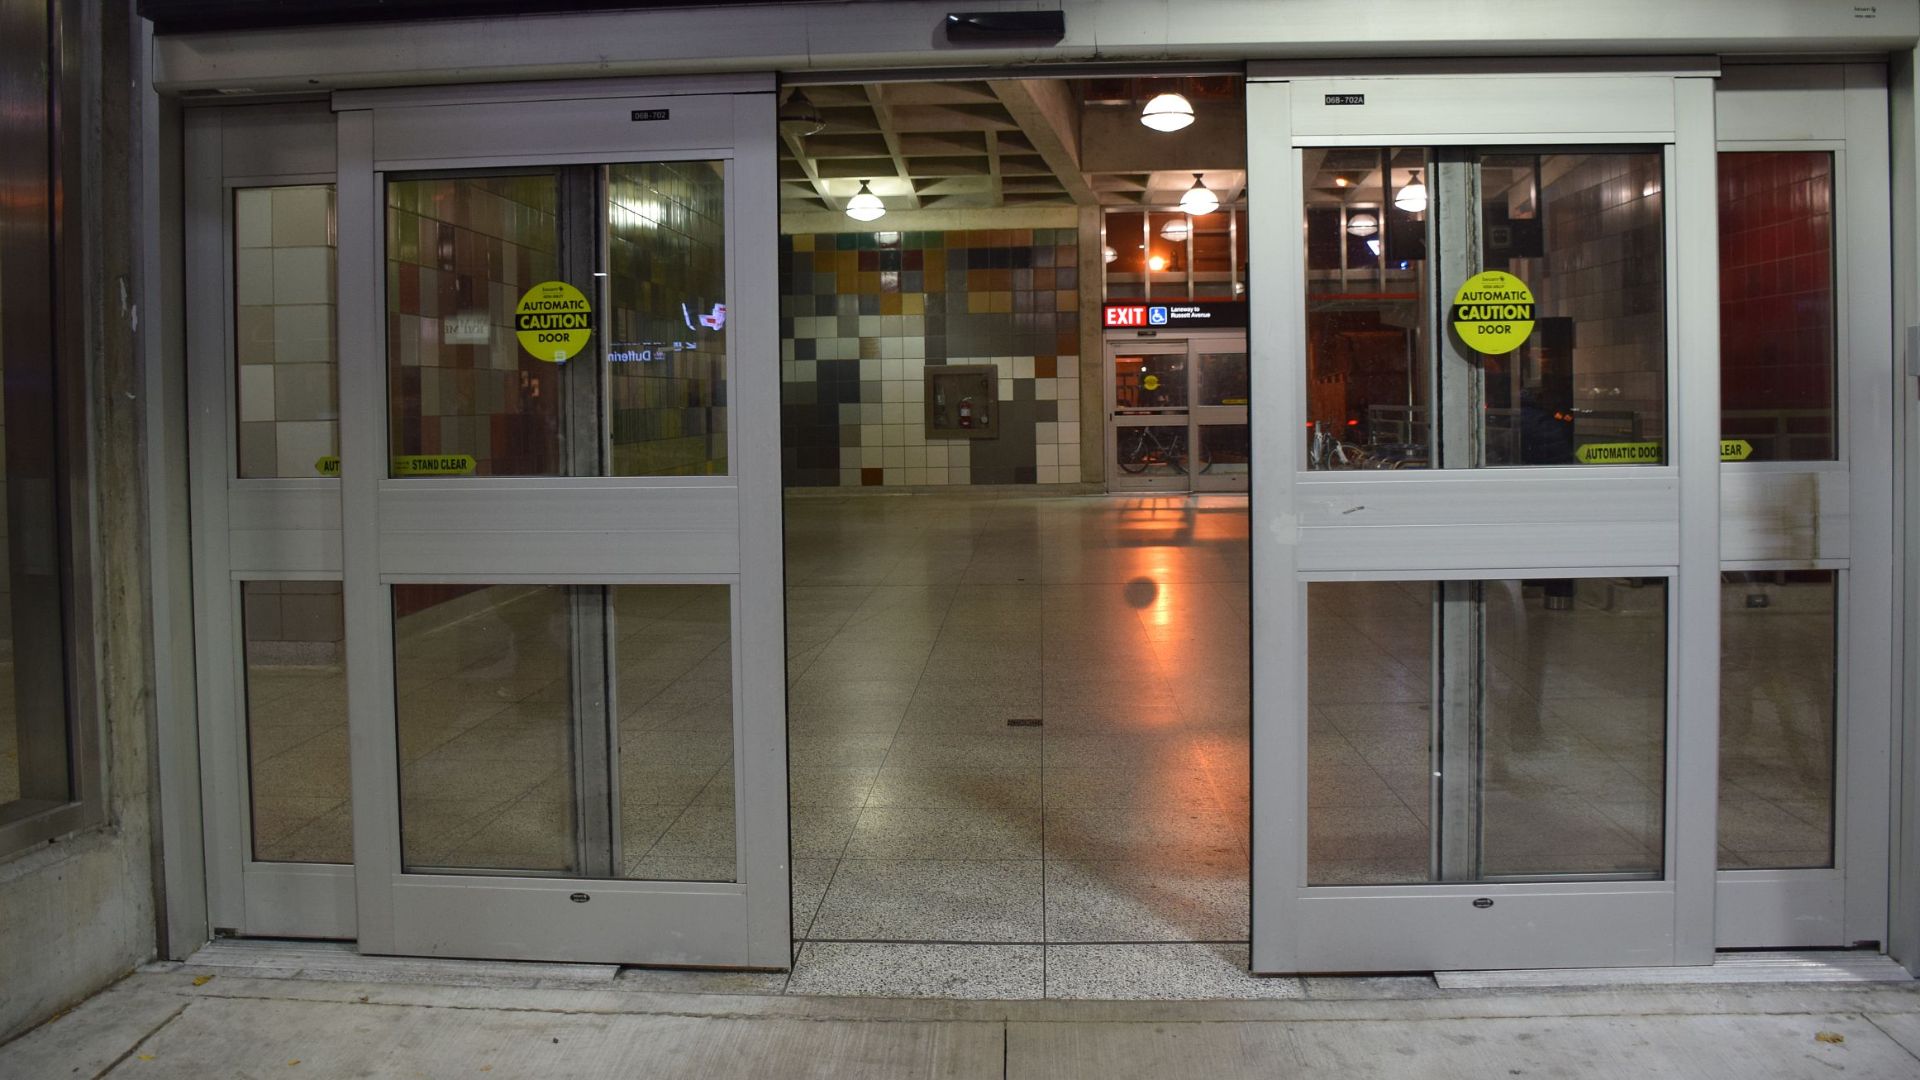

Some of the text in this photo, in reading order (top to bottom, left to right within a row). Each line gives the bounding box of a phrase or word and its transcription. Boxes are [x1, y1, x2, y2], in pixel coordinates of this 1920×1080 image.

[1325, 96, 1364, 104] 06B-702A
[1461, 291, 1527, 301] AUTOMATIC
[523, 300, 585, 311] AUTOMATIC
[1106, 307, 1144, 325] EXIT
[1458, 304, 1530, 320] CAUTION
[520, 313, 588, 330] CAUTION
[1477, 324, 1512, 335] DOOR
[538, 332, 570, 343] DOOR
[1585, 446, 1636, 460] AUTOMATIC
[1719, 444, 1742, 456] LEAR
[411, 459, 439, 470] STAND
[440, 458, 468, 470] CLEAR
